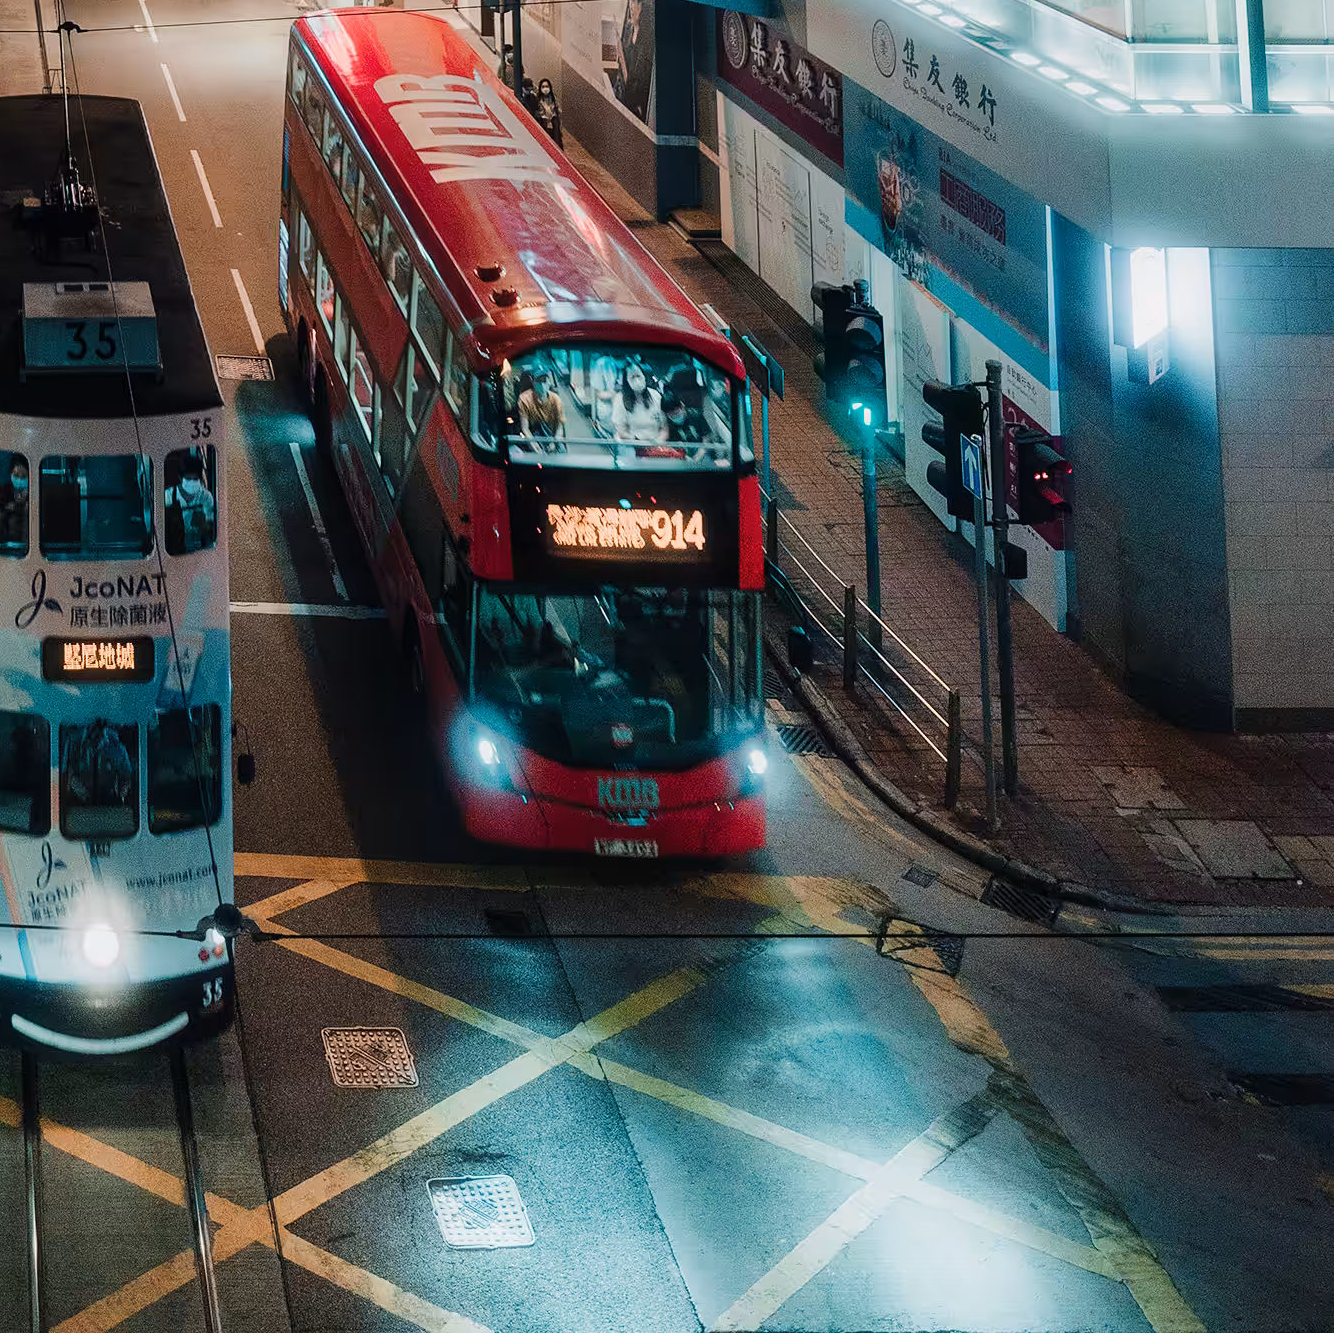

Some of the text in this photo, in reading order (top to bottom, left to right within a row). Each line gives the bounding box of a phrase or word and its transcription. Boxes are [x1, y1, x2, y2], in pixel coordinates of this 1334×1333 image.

[750, 22, 838, 118] 集友銀行
[902, 37, 997, 126] 集友銀行
[373, 73, 578, 190] KMB
[946, 102, 982, 133] Corporation
[940, 167, 1007, 247] 工商服務
[66, 322, 117, 360] 35
[190, 417, 212, 439] 35
[650, 509, 706, 551] 914
[70, 572, 167, 599] JcoNAT
[70, 603, 168, 628] 原生除菌液
[62, 641, 135, 671] 堅尼地城
[597, 776, 661, 808] KMB
[201, 976, 224, 1007] 35
